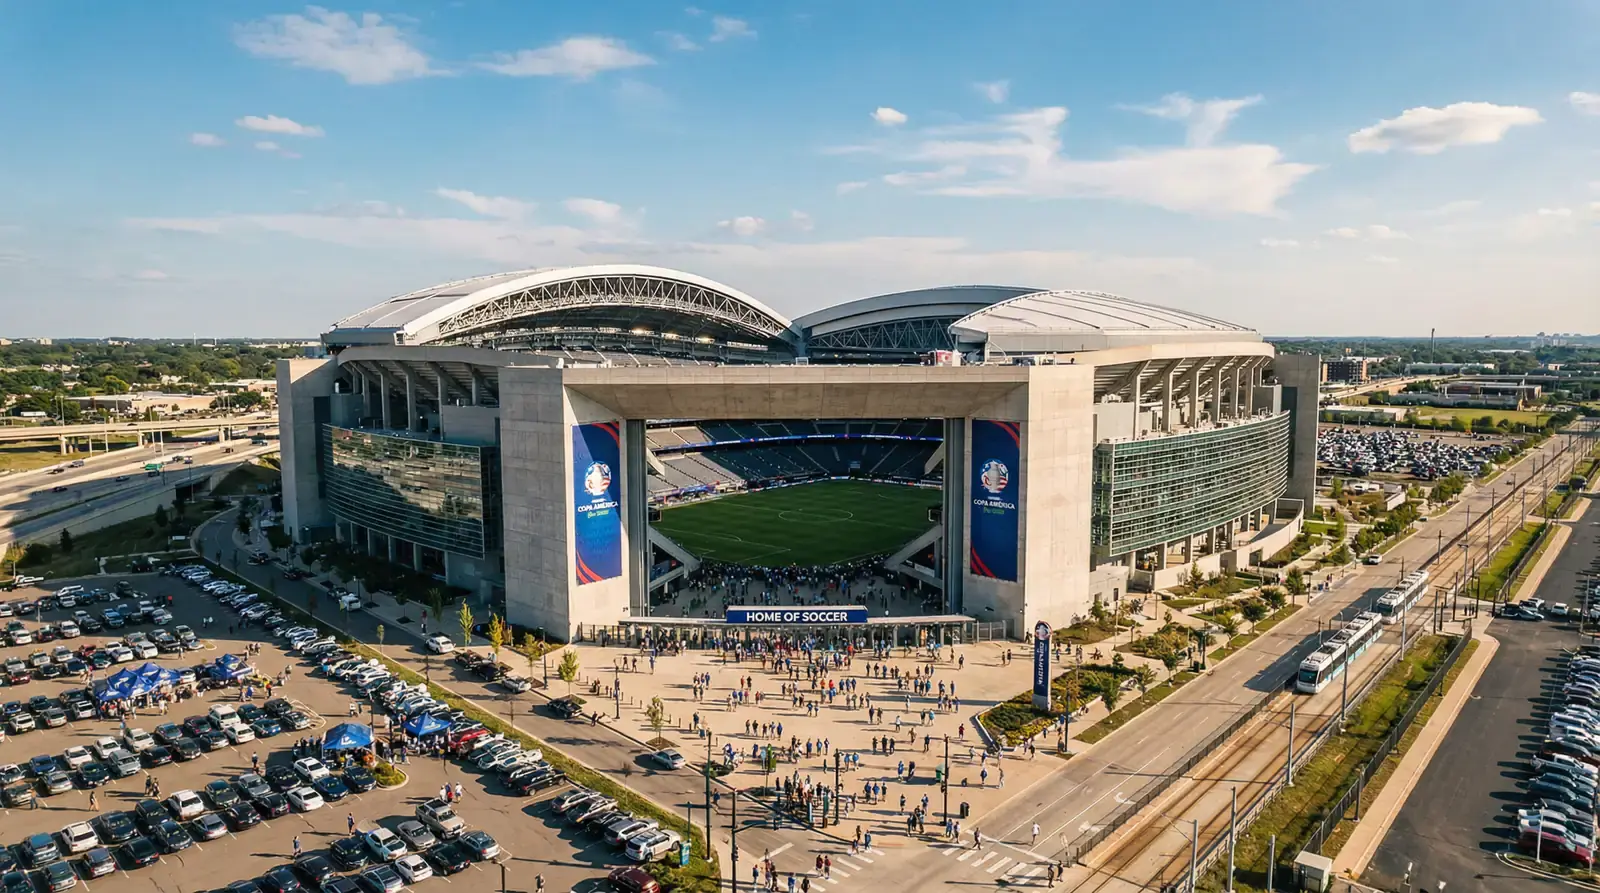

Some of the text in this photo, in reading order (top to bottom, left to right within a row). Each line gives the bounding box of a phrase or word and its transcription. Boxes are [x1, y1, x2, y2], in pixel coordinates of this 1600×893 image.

[746, 612, 848, 621] HOME OF SOCCER
